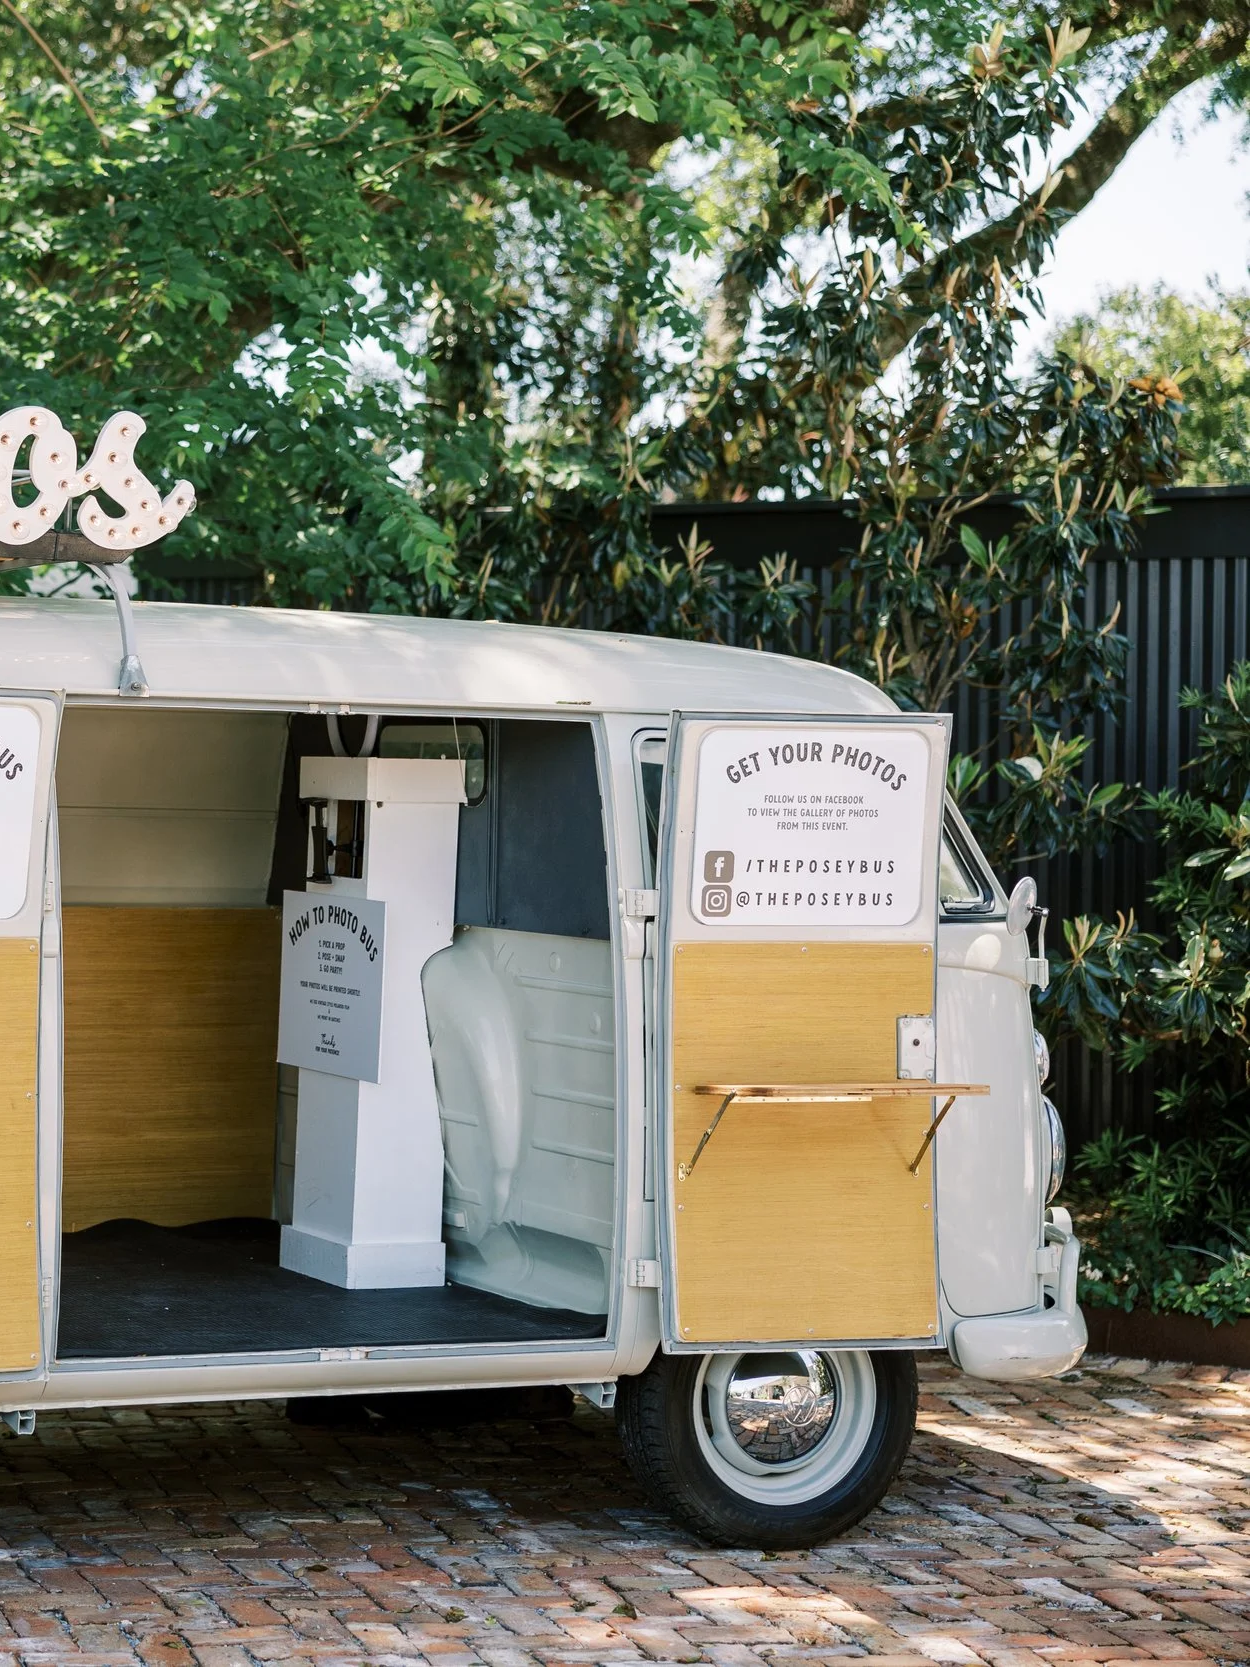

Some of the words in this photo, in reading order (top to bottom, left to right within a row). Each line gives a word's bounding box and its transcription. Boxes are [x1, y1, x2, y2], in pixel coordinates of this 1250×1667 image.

[727, 752, 761, 783] GET
[769, 742, 822, 765] YOUR
[832, 744, 907, 791] PHOTOS
[764, 795, 794, 803] FOLLOW
[825, 796, 863, 804] FACEBOOK
[748, 808, 757, 816] TO
[800, 809, 833, 817] GALLERY
[849, 810, 878, 818] PHOTOS
[777, 822, 798, 830] FROM
[802, 822, 819, 830] THIS
[822, 823, 848, 831] EVENT.
[746, 860, 895, 873] /THEPOSEYBUS
[736, 892, 893, 907] @THEPOSEYBUS
[289, 912, 310, 946] HOW
[313, 905, 324, 925] TO
[328, 905, 358, 933] PHOTO
[360, 925, 378, 962] BUS
